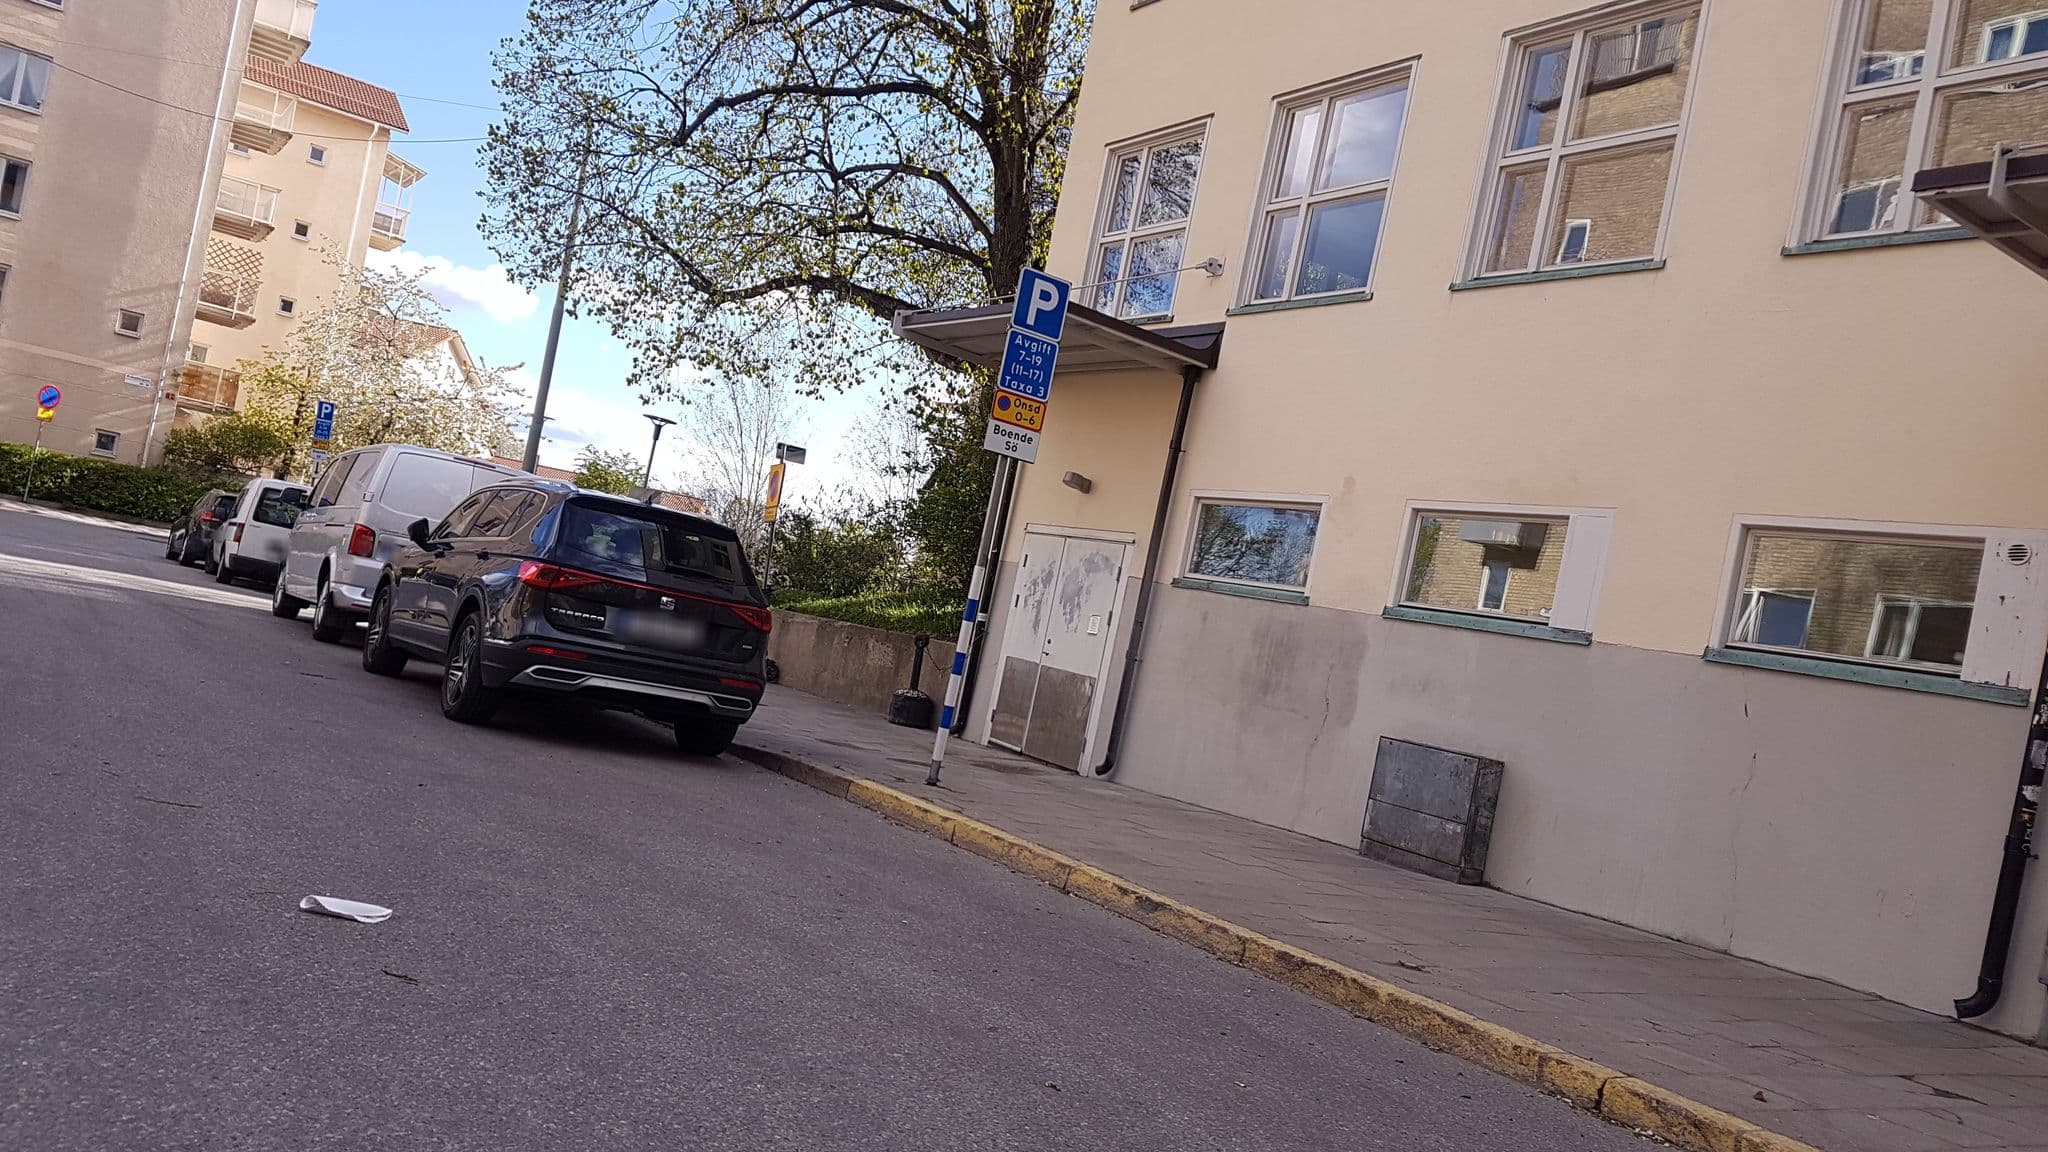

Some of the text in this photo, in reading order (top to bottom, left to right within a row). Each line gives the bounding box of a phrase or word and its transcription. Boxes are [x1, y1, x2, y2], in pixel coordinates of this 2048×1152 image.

[1026, 277, 1060, 326] P
[1015, 334, 1051, 355] Avgift
[1019, 350, 1042, 366] 7-19
[1011, 362, 1044, 383] (11-17)
[1005, 375, 1045, 397] Taxa 3
[321, 403, 332, 418] P
[1014, 398, 1041, 414] Onsd
[1015, 411, 1036, 425] 0-6
[993, 424, 1033, 444] Boende
[1004, 441, 1019, 452] Sö
